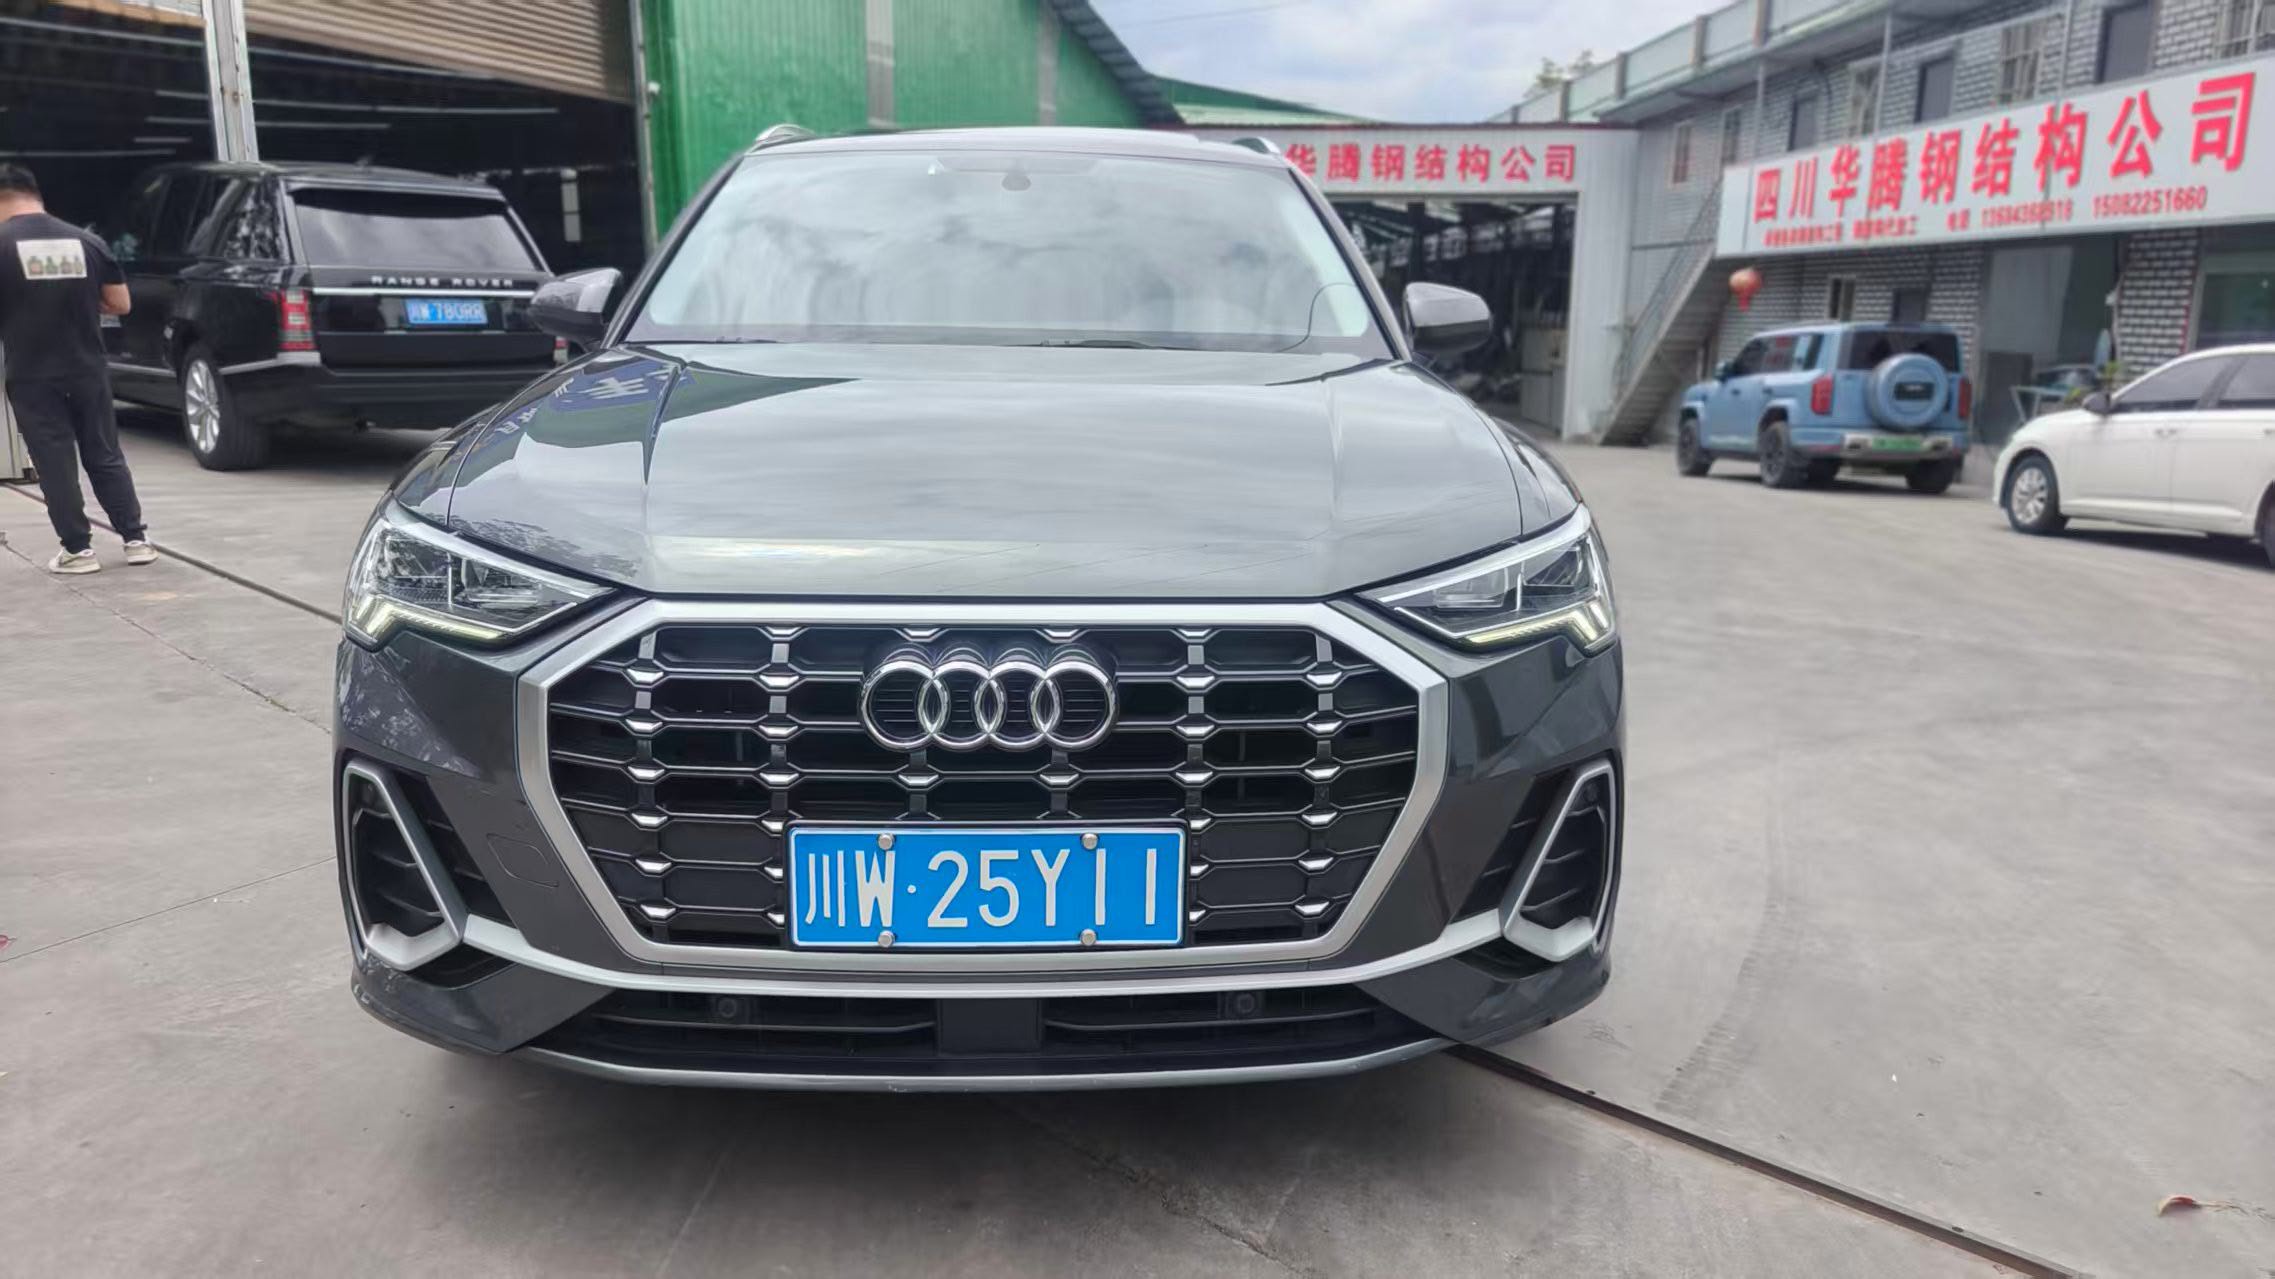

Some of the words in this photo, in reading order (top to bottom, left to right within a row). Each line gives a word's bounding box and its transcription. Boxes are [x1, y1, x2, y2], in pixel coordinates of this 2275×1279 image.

[1285, 142, 1576, 183] 华腾钢结构公司
[1754, 72, 2255, 223] 四川华腾钢结构公司
[371, 275, 440, 287] RANGE
[452, 277, 513, 288] ROVER
